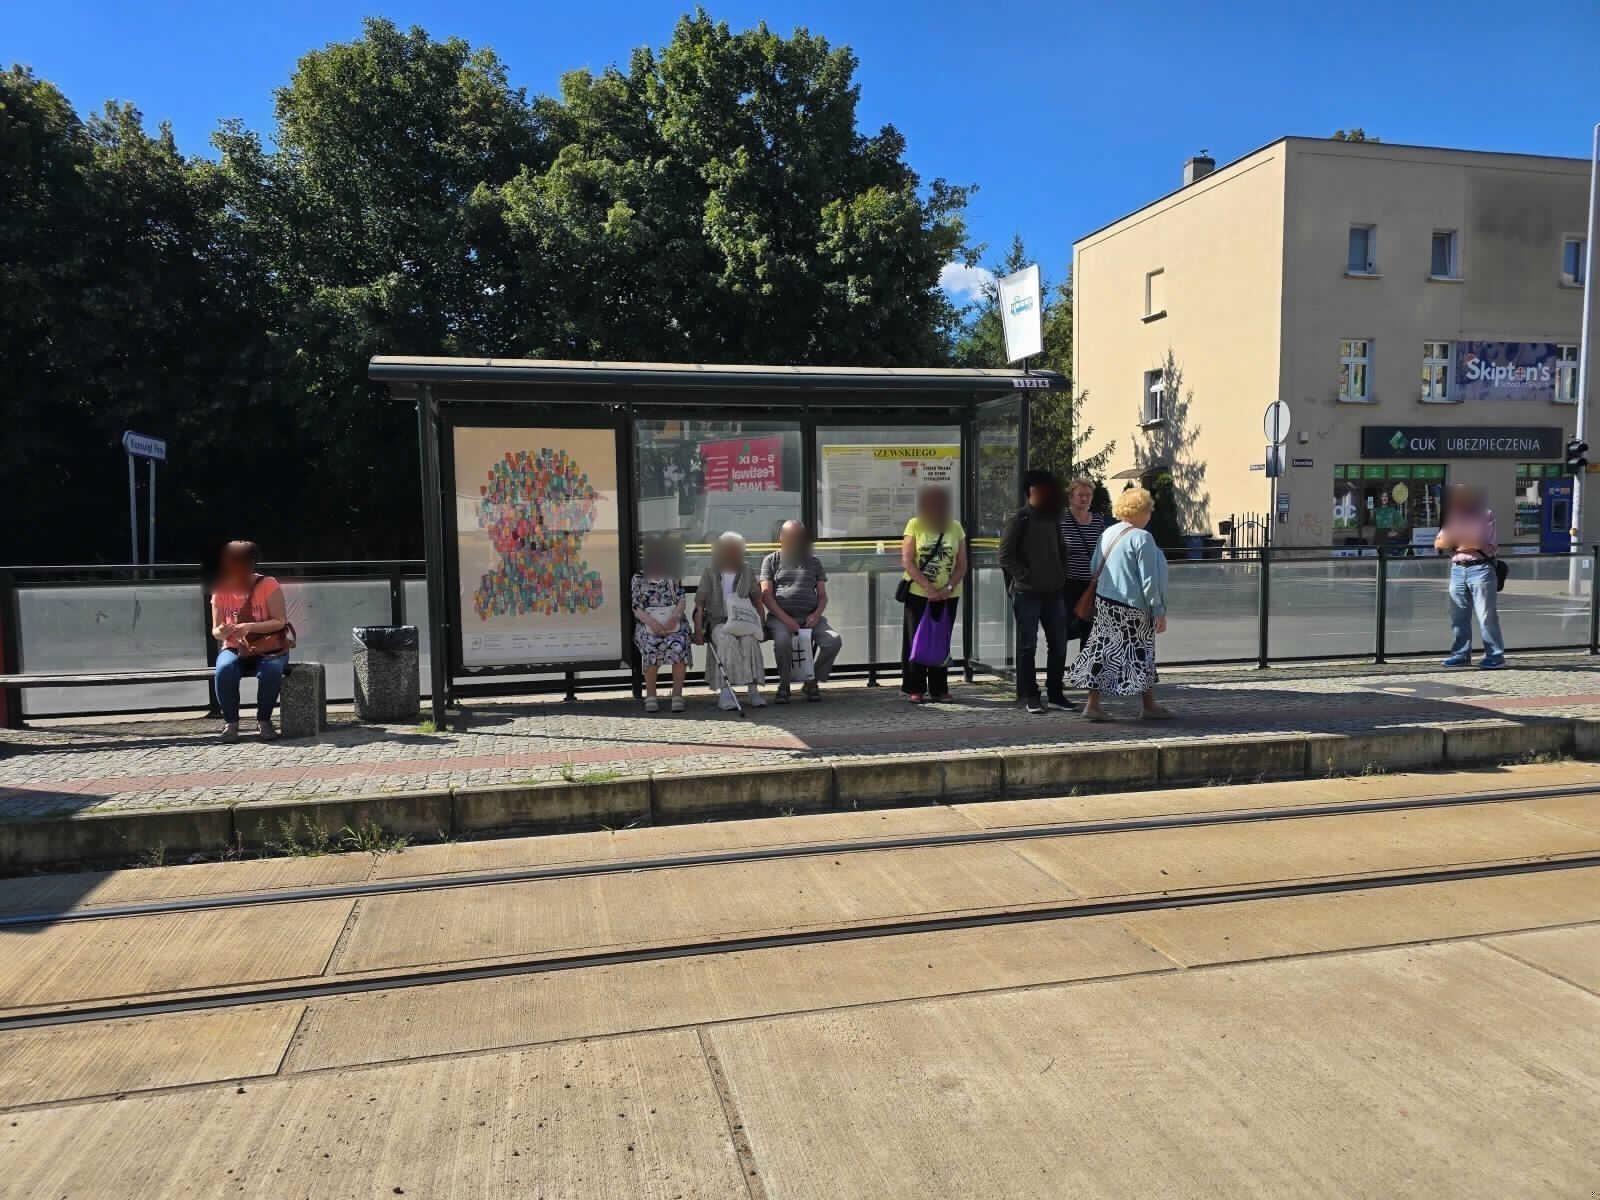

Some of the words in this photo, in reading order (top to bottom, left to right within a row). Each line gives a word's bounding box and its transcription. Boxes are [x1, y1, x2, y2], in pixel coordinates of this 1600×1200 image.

[1466, 357, 1551, 387] Skipton's
[1410, 438, 1436, 451] CUK
[1446, 438, 1541, 451] UBEZPIECZENIA
